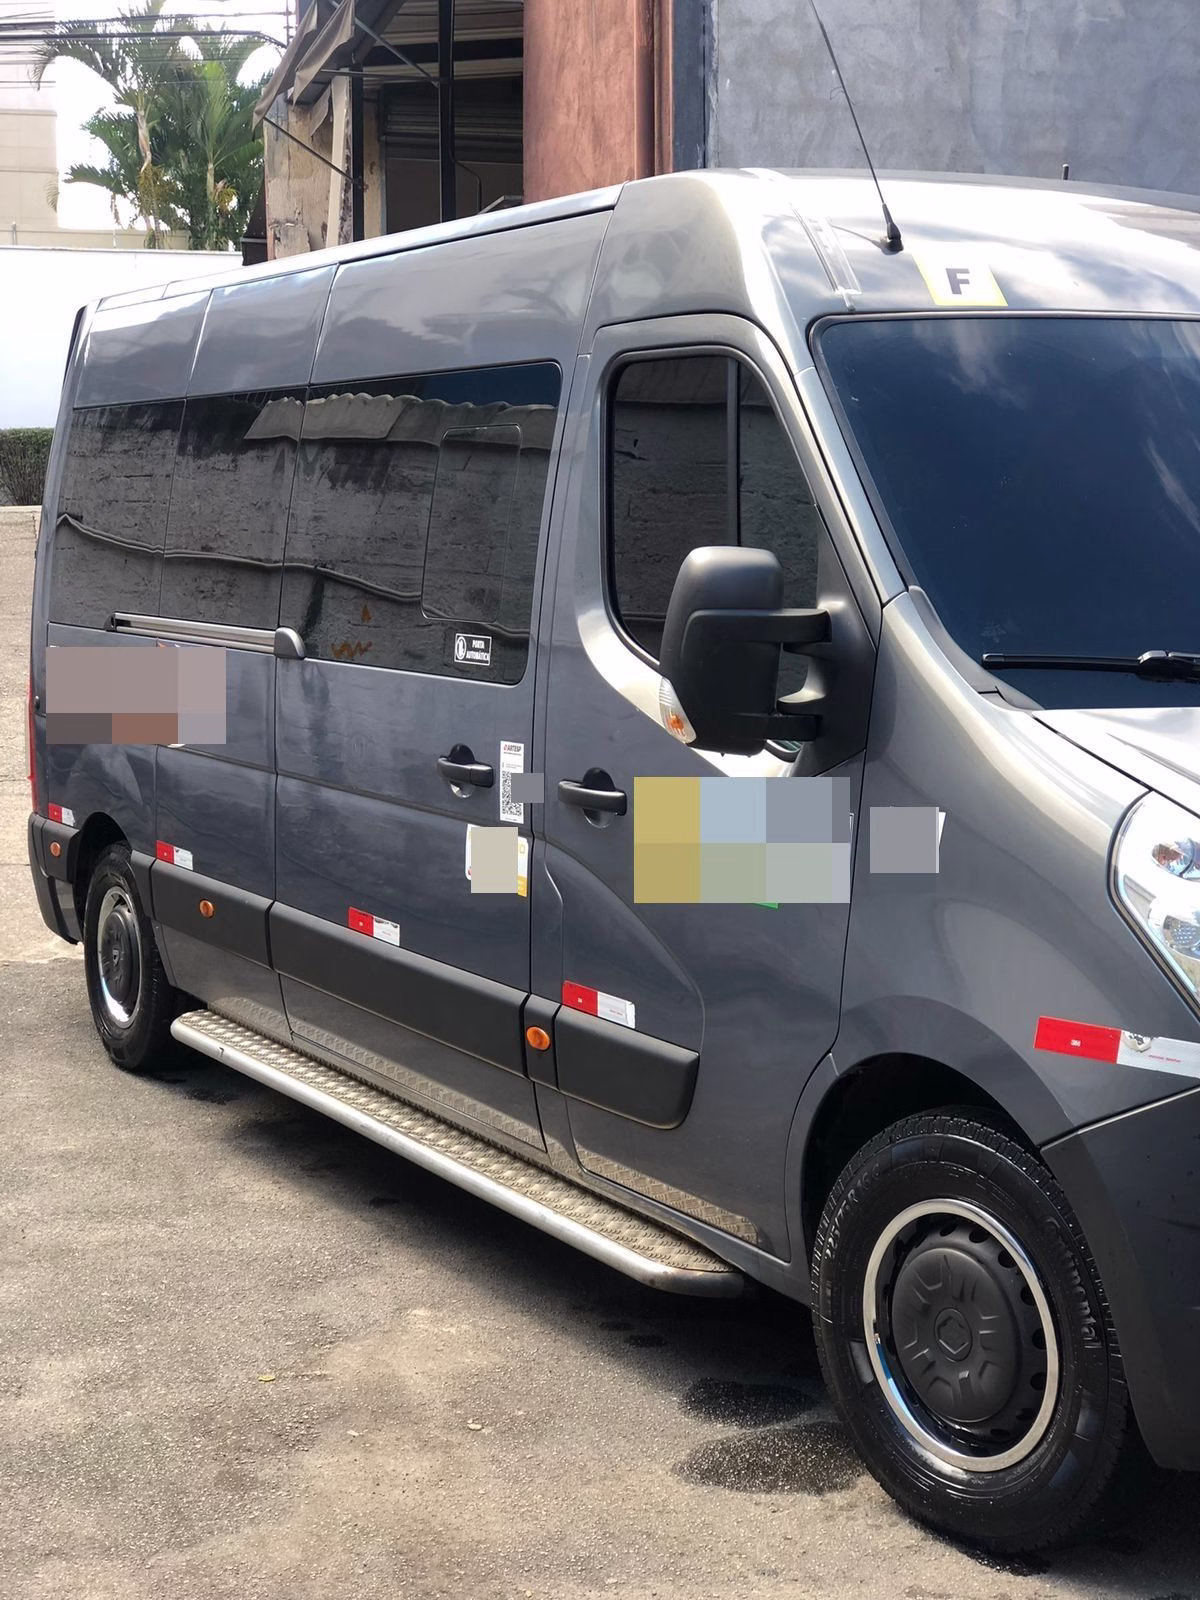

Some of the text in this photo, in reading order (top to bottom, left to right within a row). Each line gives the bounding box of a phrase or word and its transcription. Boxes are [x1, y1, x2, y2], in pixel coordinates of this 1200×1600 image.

[945, 267, 970, 295] F
[472, 640, 485, 649] PORTA
[1070, 1039, 1080, 1047] 3M
[1042, 1215, 1103, 1349] Continental
